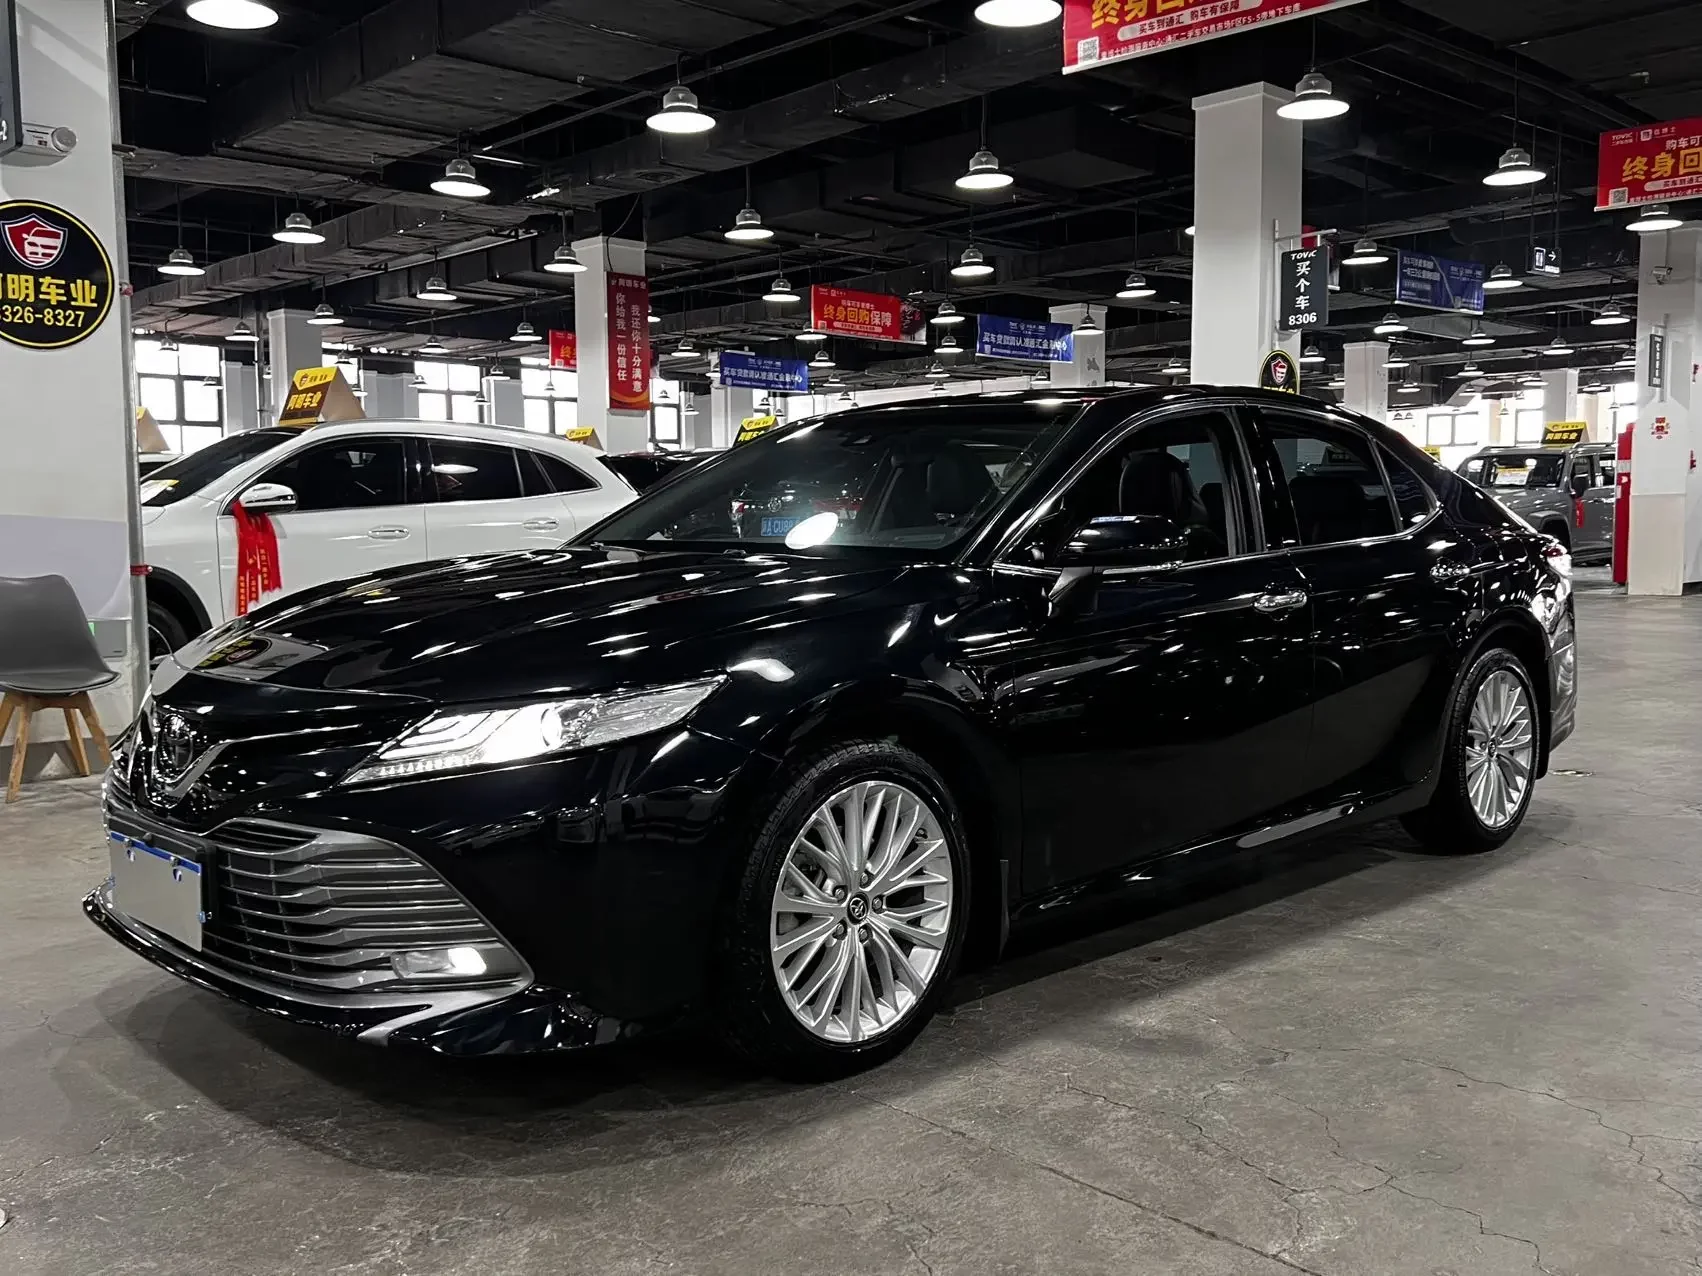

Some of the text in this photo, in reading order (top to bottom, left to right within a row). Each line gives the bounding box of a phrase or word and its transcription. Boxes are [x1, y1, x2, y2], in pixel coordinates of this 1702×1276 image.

[1139, 0, 1240, 35] 买车到通汇 购车有保障
[1622, 149, 1702, 182] 终身回
[0, 273, 98, 307] 明车业
[1295, 260, 1311, 310] 买个车
[0, 305, 85, 328] 326-8327
[823, 303, 892, 328] 终身回购保障
[1288, 312, 1317, 326] 8306
[615, 292, 627, 381] 你给我一份信任
[631, 304, 642, 393] 我还你十分满意
